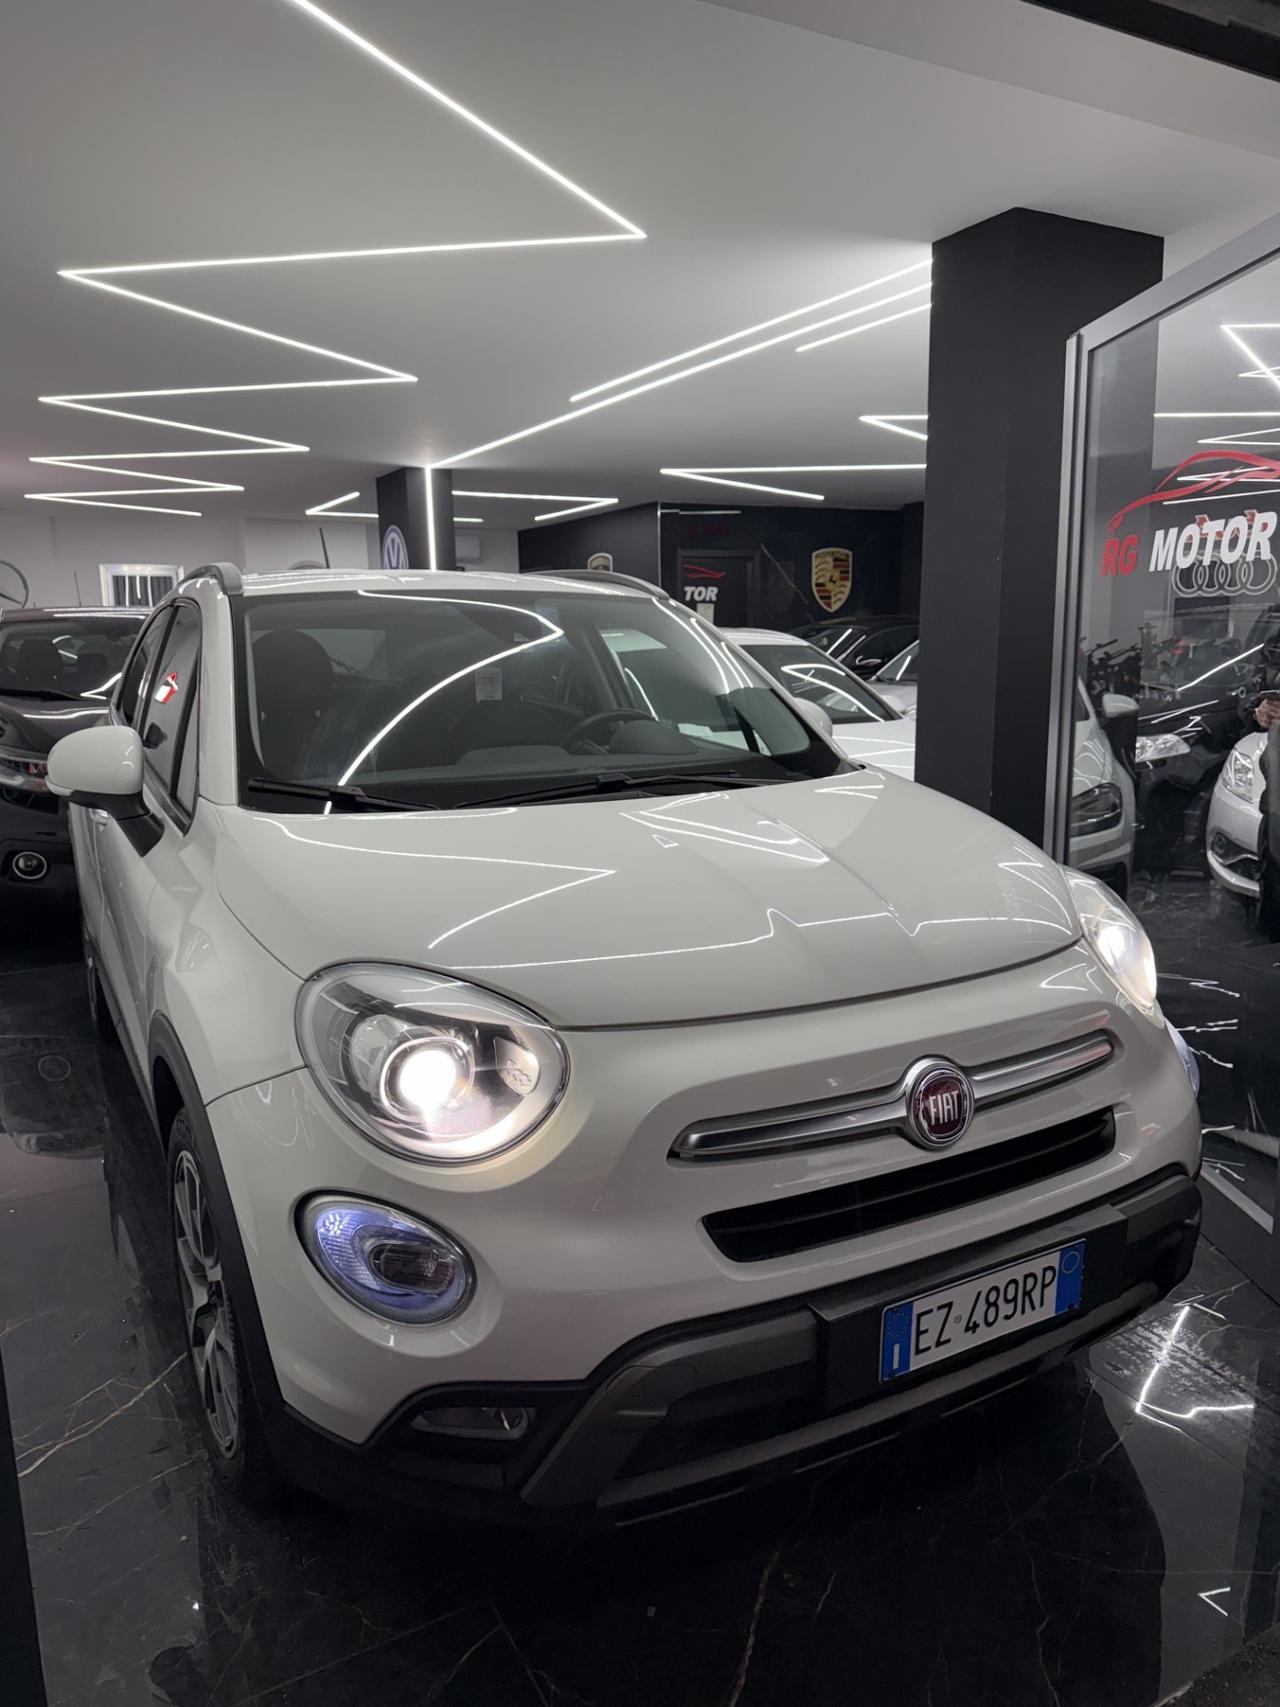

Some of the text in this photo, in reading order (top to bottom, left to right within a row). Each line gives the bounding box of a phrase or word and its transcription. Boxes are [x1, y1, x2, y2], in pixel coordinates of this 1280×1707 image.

[1101, 511, 1278, 577] RG MOTOR
[684, 586, 718, 602] TOR
[928, 1089, 960, 1126] FIAT
[914, 1300, 954, 1355] EZ
[964, 1264, 1057, 1335] 489RP
